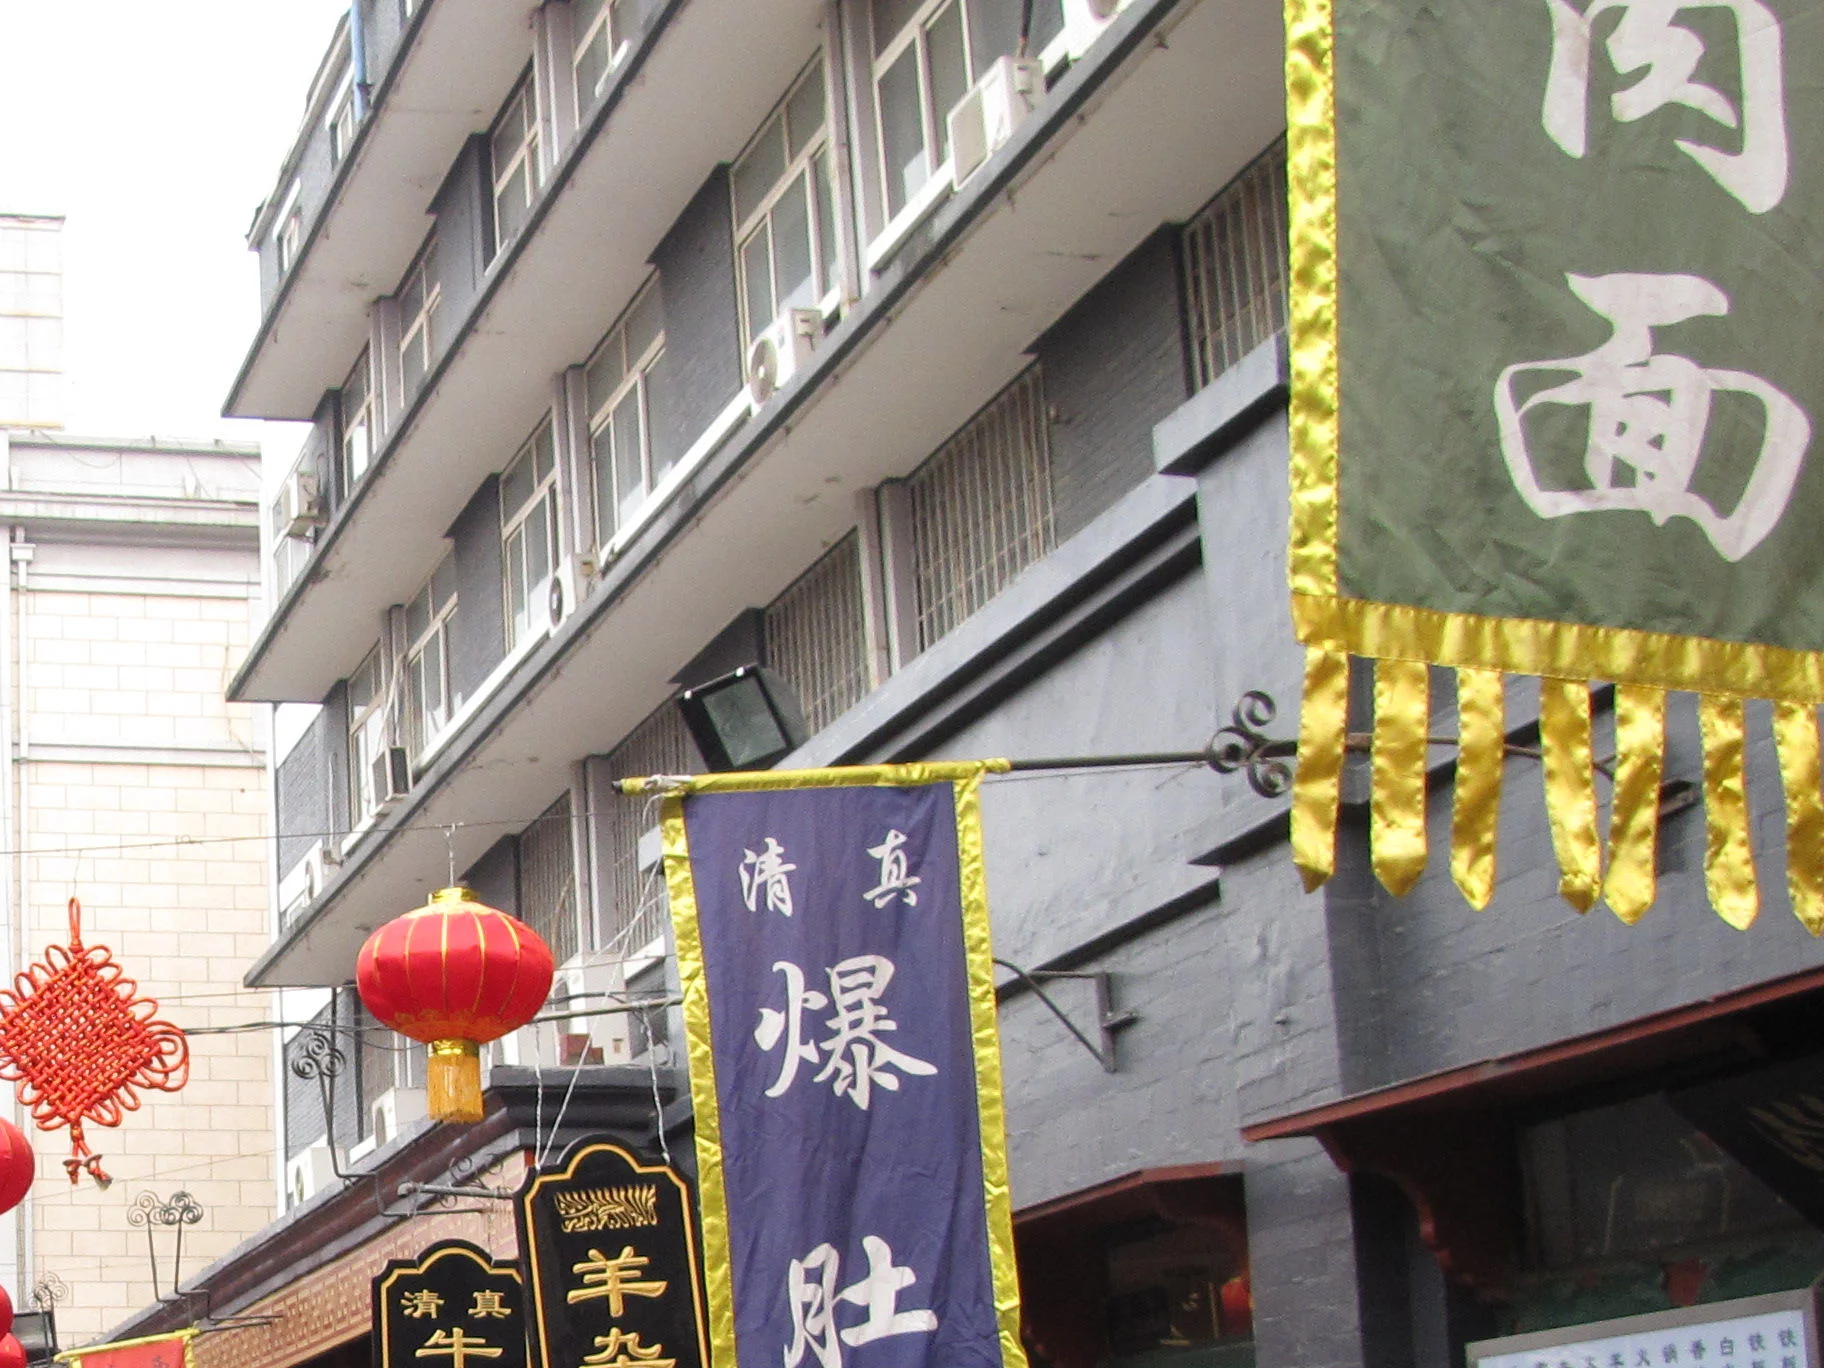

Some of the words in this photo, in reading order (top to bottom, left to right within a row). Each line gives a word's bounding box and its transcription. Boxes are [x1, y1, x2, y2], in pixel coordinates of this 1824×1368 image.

[1494, 0, 1811, 563] 肉面
[738, 829, 922, 917] 清真
[400, 1288, 513, 1322] 清真
